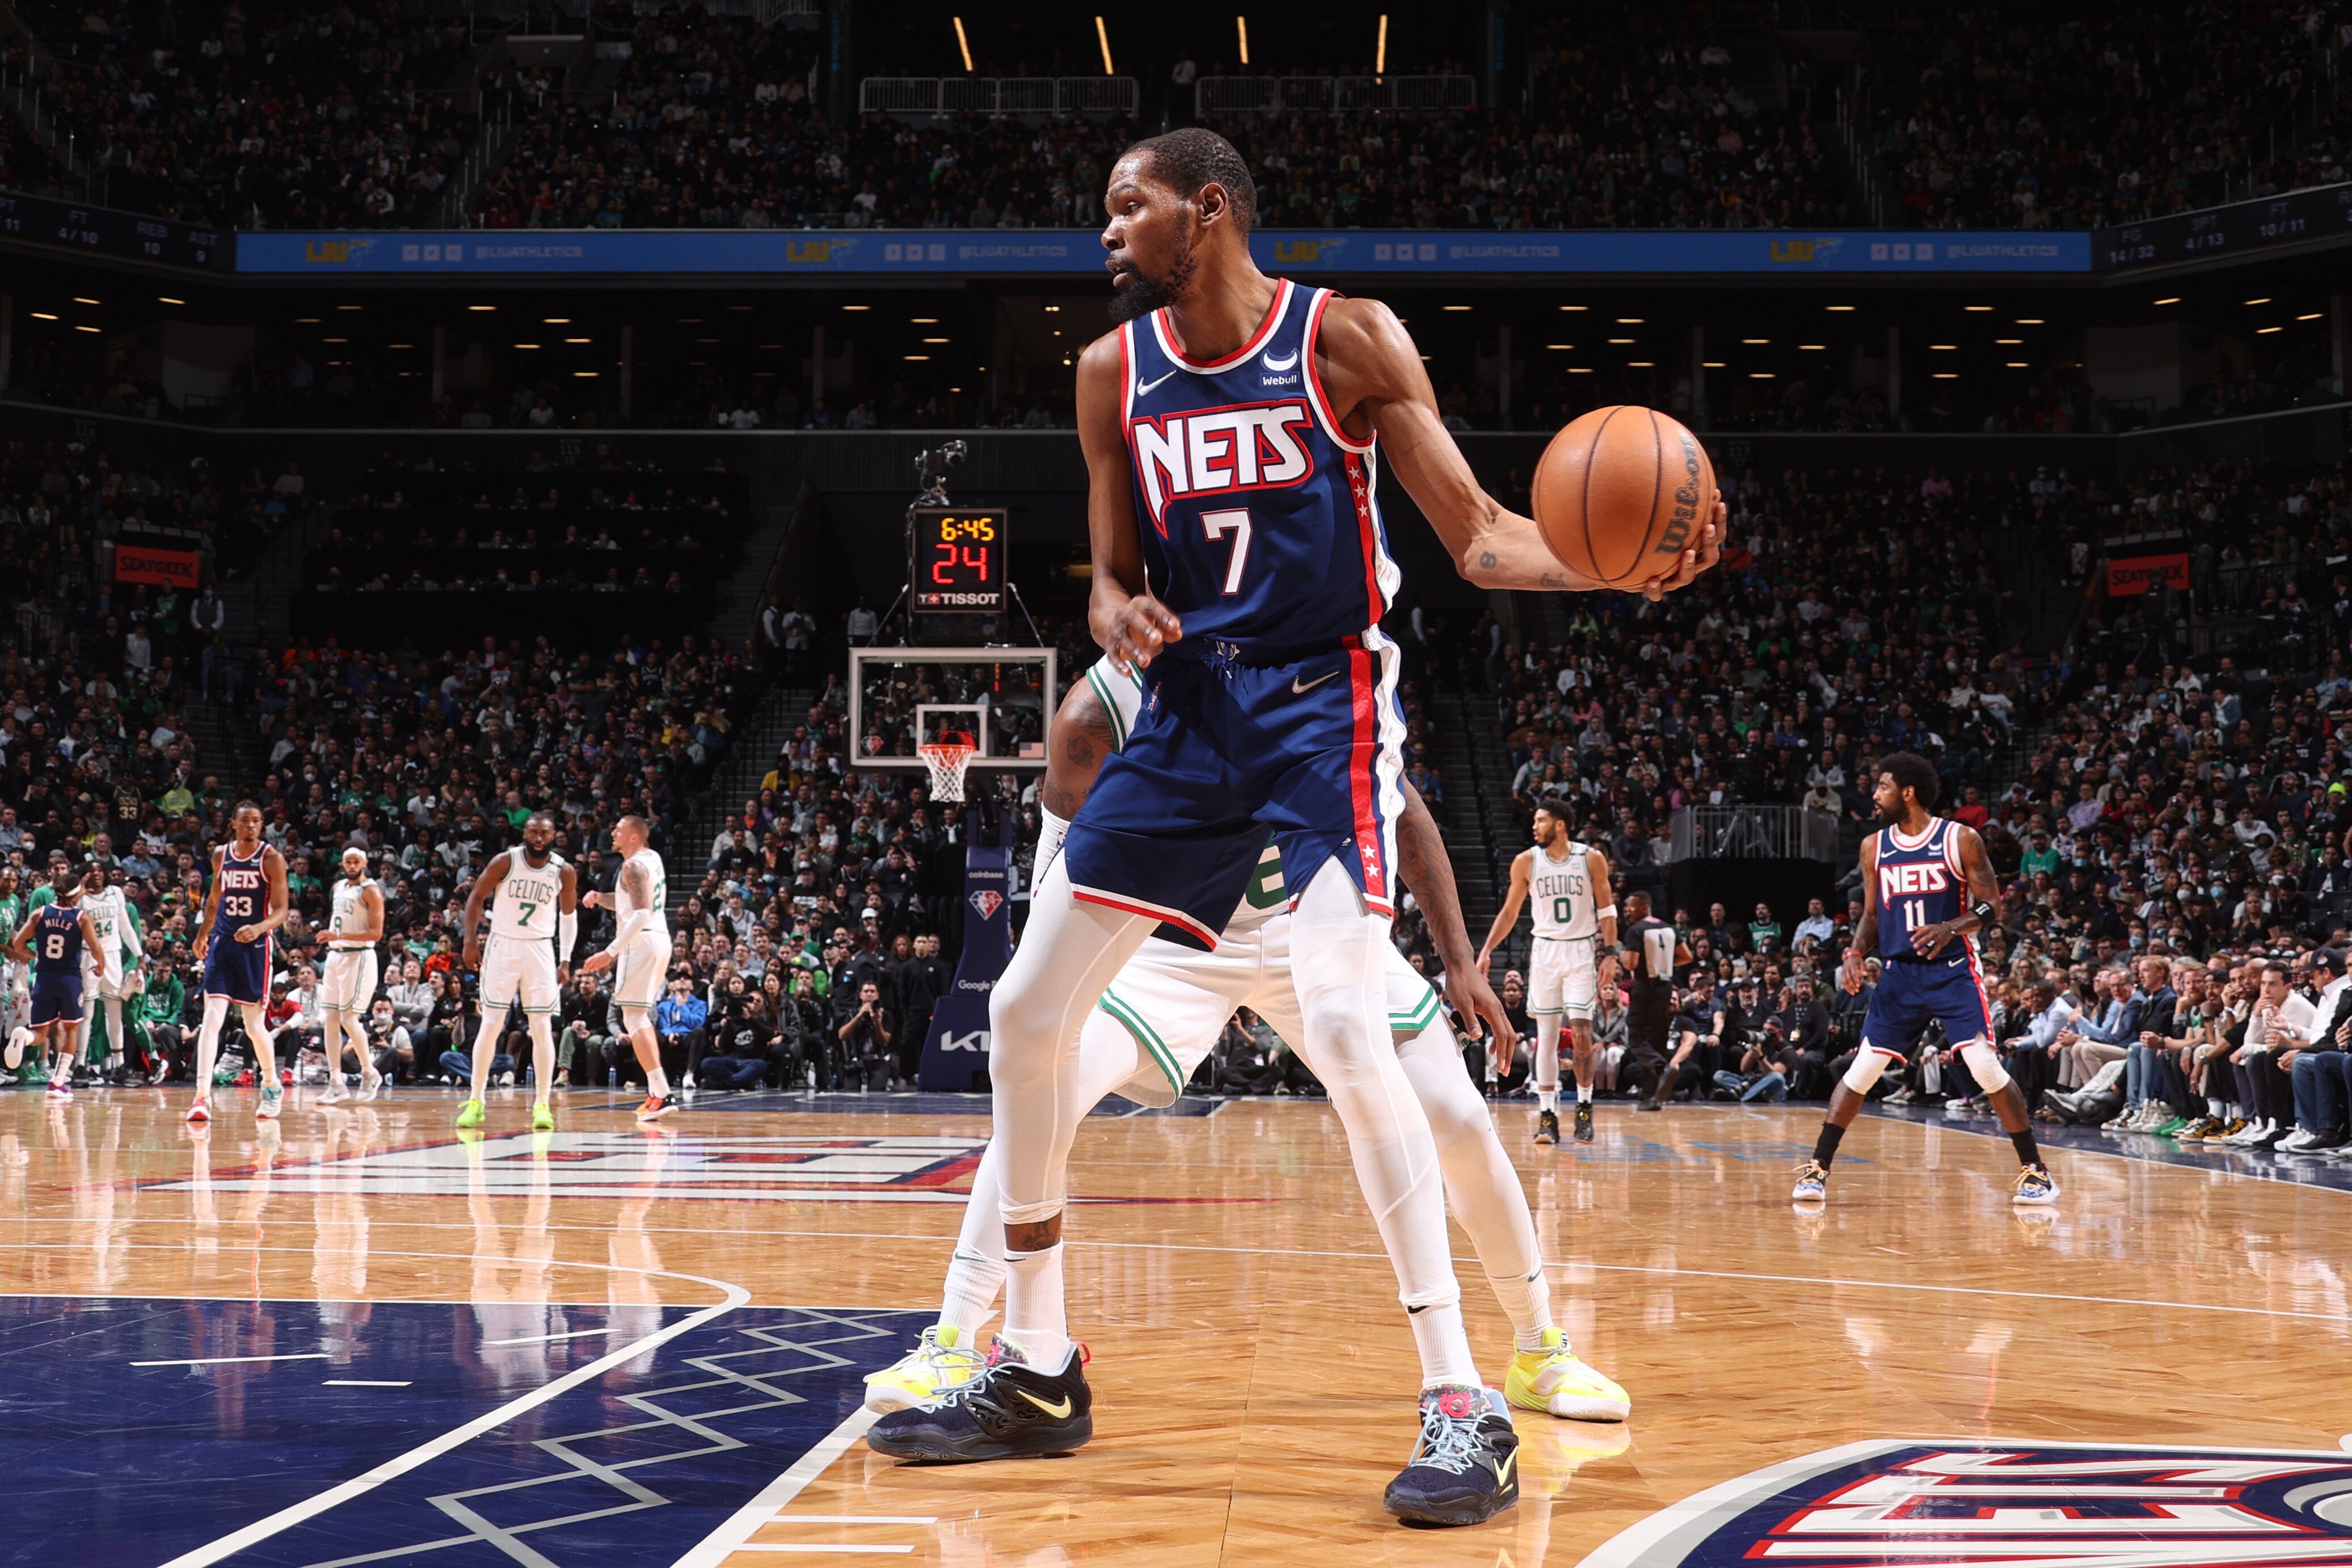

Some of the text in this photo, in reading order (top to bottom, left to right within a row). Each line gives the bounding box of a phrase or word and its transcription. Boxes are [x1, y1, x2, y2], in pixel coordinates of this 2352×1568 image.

[70, 210, 88, 225] FT
[137, 222, 168, 238] REB
[188, 231, 218, 247] AST
[143, 241, 161, 255] 10
[196, 250, 206, 263] 9
[306, 242, 348, 262] LIU
[787, 242, 829, 262] LIU
[1275, 241, 1319, 262] LIU
[1770, 241, 1814, 262] LIU
[1263, 375, 1297, 386] Webull
[1130, 399, 1313, 538] NETS
[941, 517, 994, 541] 6:45
[1199, 508, 1253, 595] 7
[120, 556, 193, 578] SEATGEEK
[932, 543, 987, 584] 24
[2112, 564, 2184, 585] SEATEK
[941, 593, 999, 605] TISSOT
[119, 806, 138, 820] 33
[221, 869, 260, 893] NETS
[509, 879, 554, 904] CELTICS
[1537, 875, 1583, 898] CELTICS
[1879, 861, 1949, 909] NETS
[225, 895, 252, 917] 33
[517, 902, 536, 926] 7
[1553, 897, 1571, 924] 0
[1903, 899, 1925, 931] 11
[44, 918, 73, 931] MILLS
[94, 920, 112, 938] 44
[334, 916, 342, 934] 9
[45, 934, 65, 960] 8
[1659, 934, 1665, 951] 4
[958, 979, 990, 992] Google
[941, 1030, 991, 1052] KI
